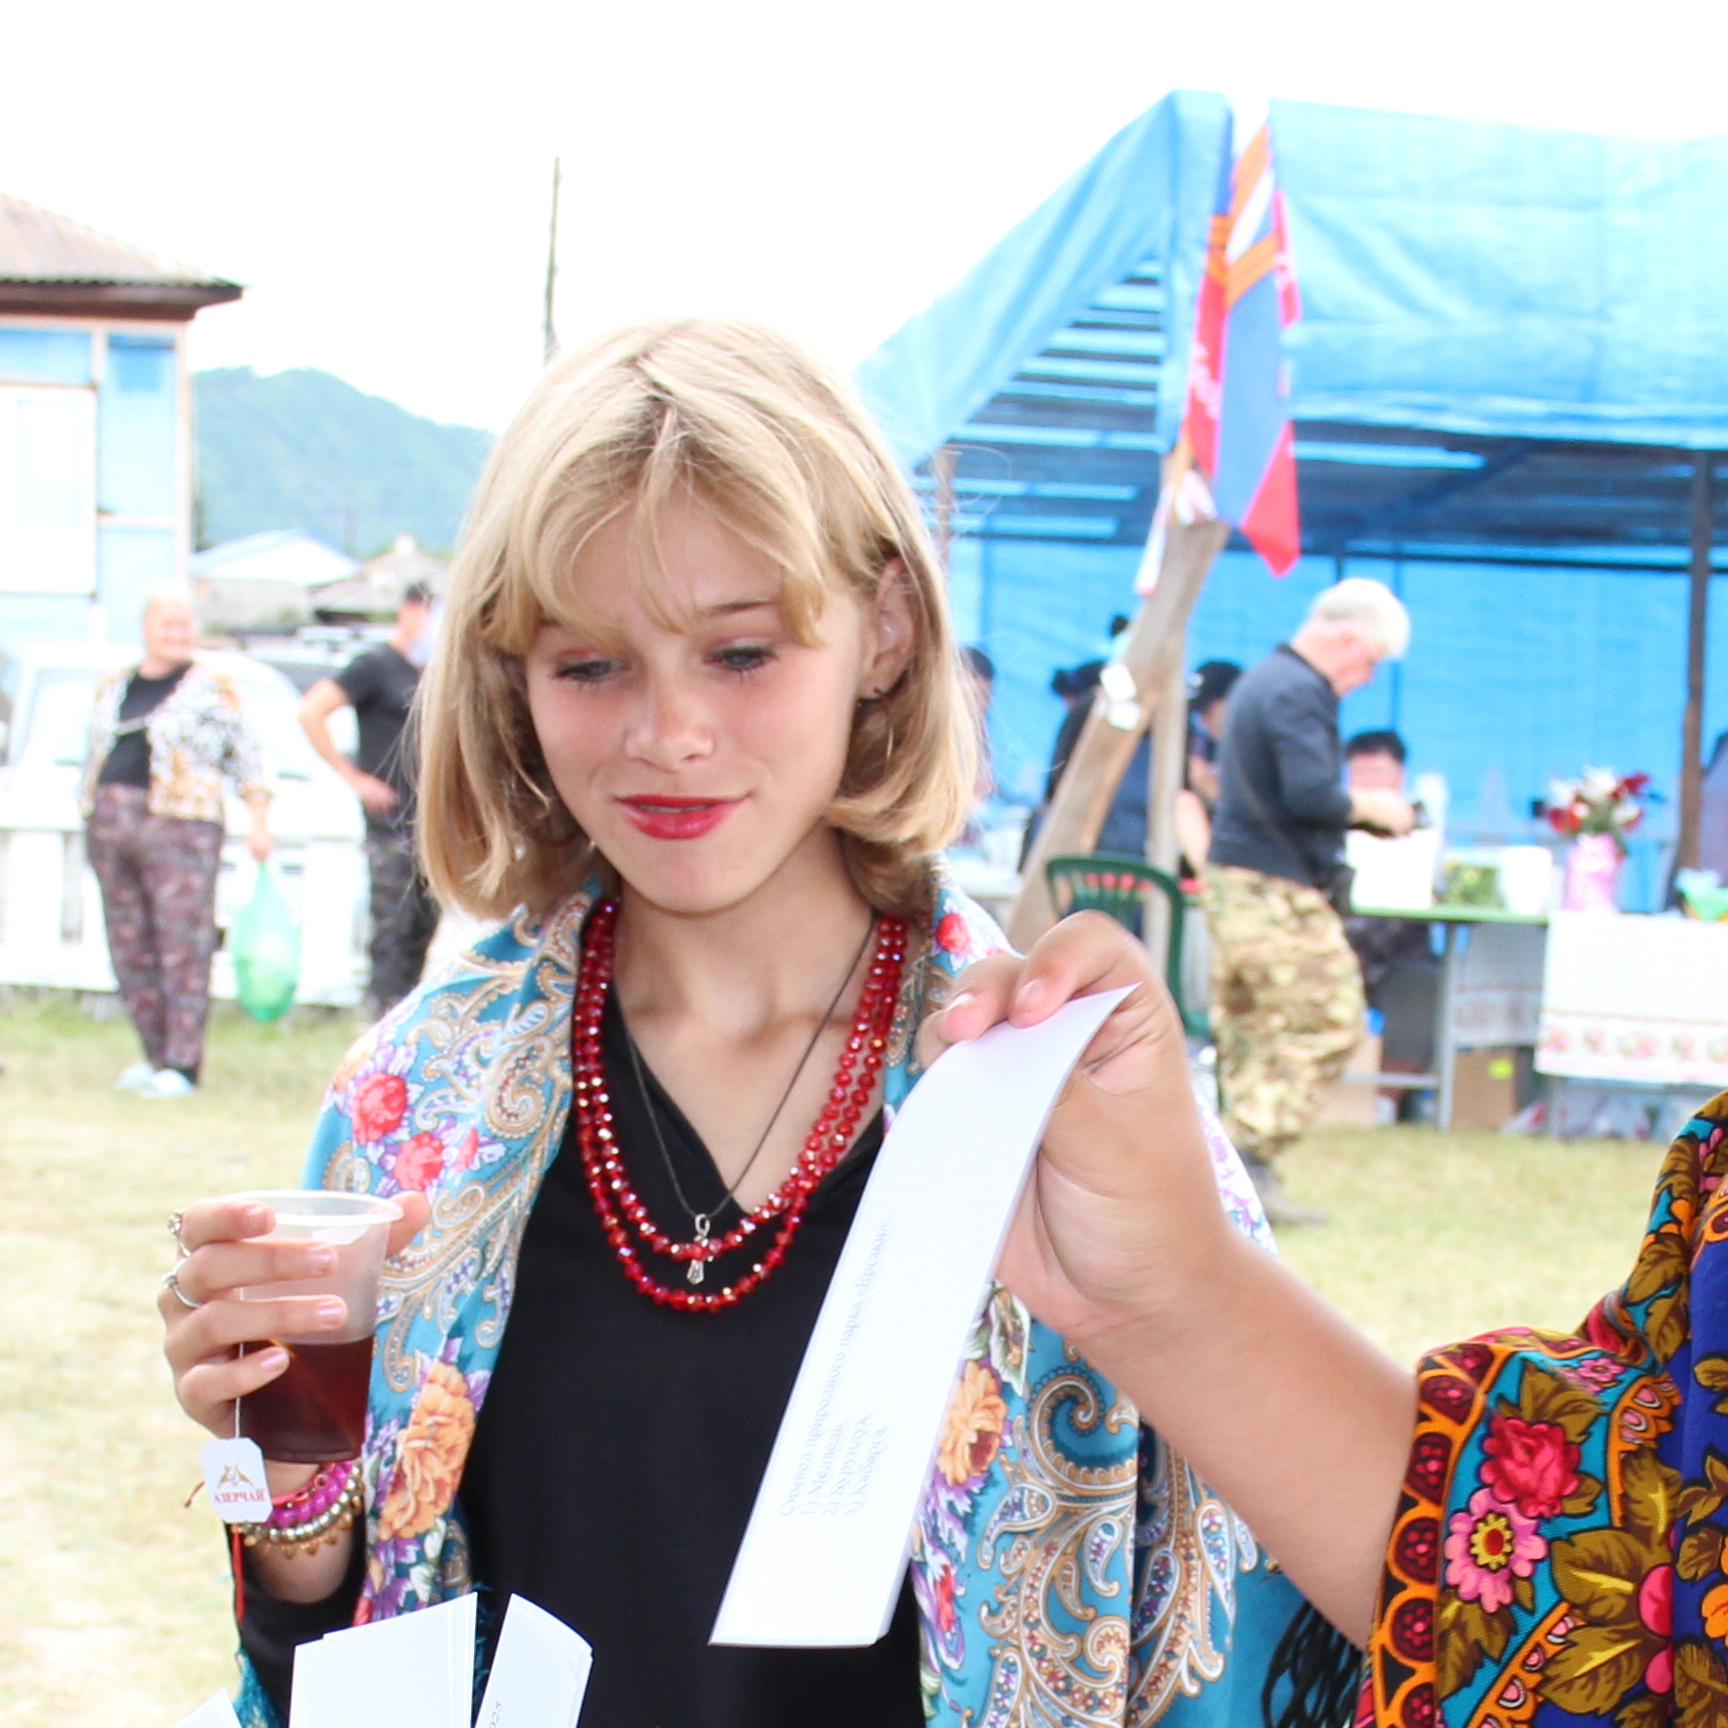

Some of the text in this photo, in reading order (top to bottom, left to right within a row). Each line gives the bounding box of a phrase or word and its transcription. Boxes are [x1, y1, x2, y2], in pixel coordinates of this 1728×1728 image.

[778, 1451, 814, 1519] Символ
[803, 1351, 847, 1448] природного
[837, 1300, 864, 1348] парка
[807, 1422, 844, 1496] Медведь
[829, 1414, 870, 1497] Бурундук
[852, 1427, 887, 1496] Кабарга
[214, 1487, 265, 1503] АЗЕРЧАЙ
